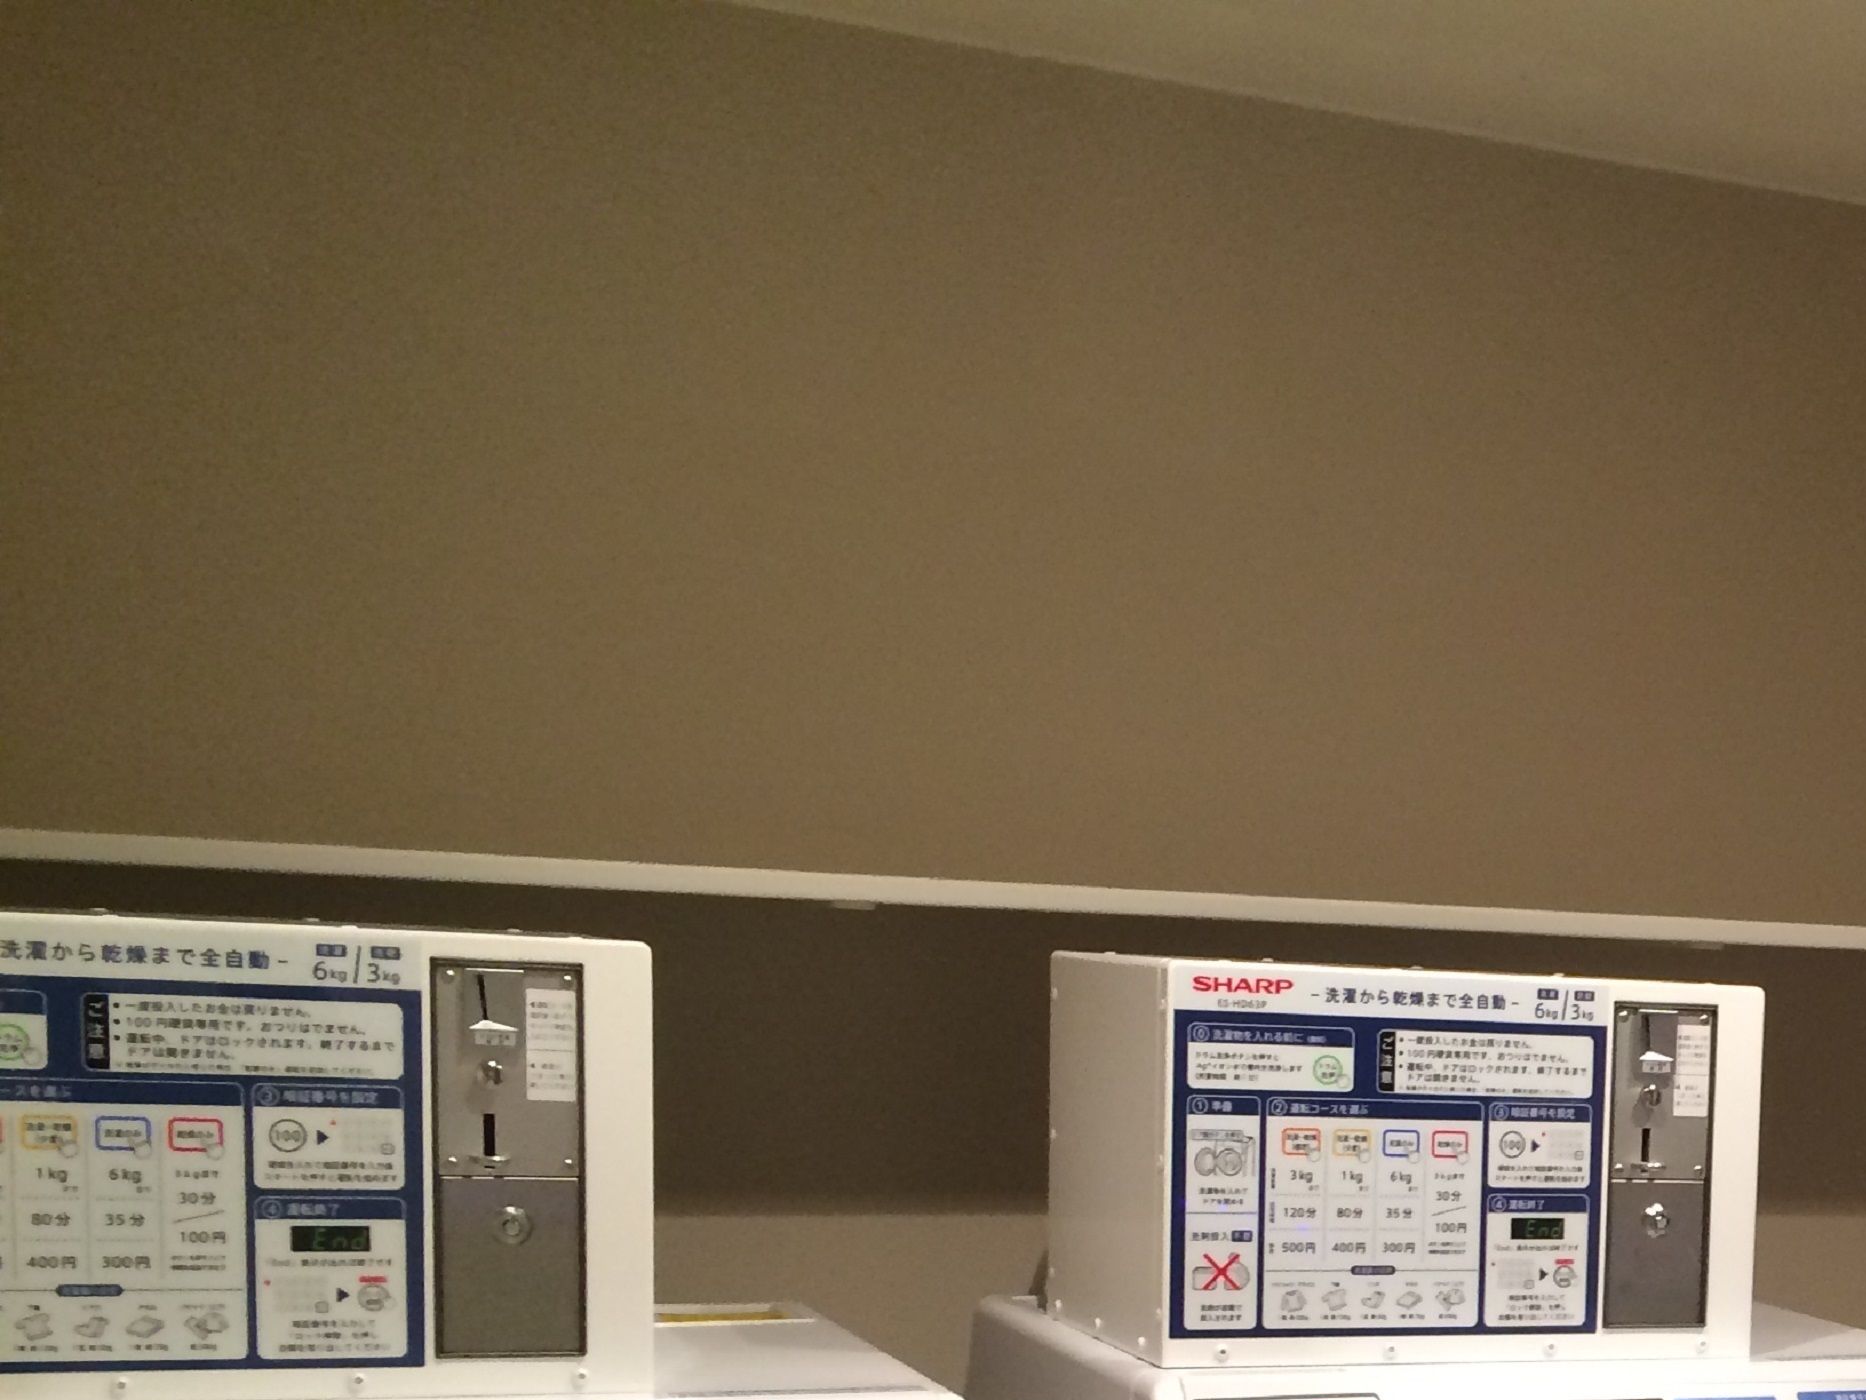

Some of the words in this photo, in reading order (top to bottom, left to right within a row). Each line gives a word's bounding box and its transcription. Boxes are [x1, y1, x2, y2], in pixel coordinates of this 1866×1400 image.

[1192, 975, 1294, 995] SHARP
[312, 1228, 367, 1250] End
[1525, 1220, 1564, 1239] End
